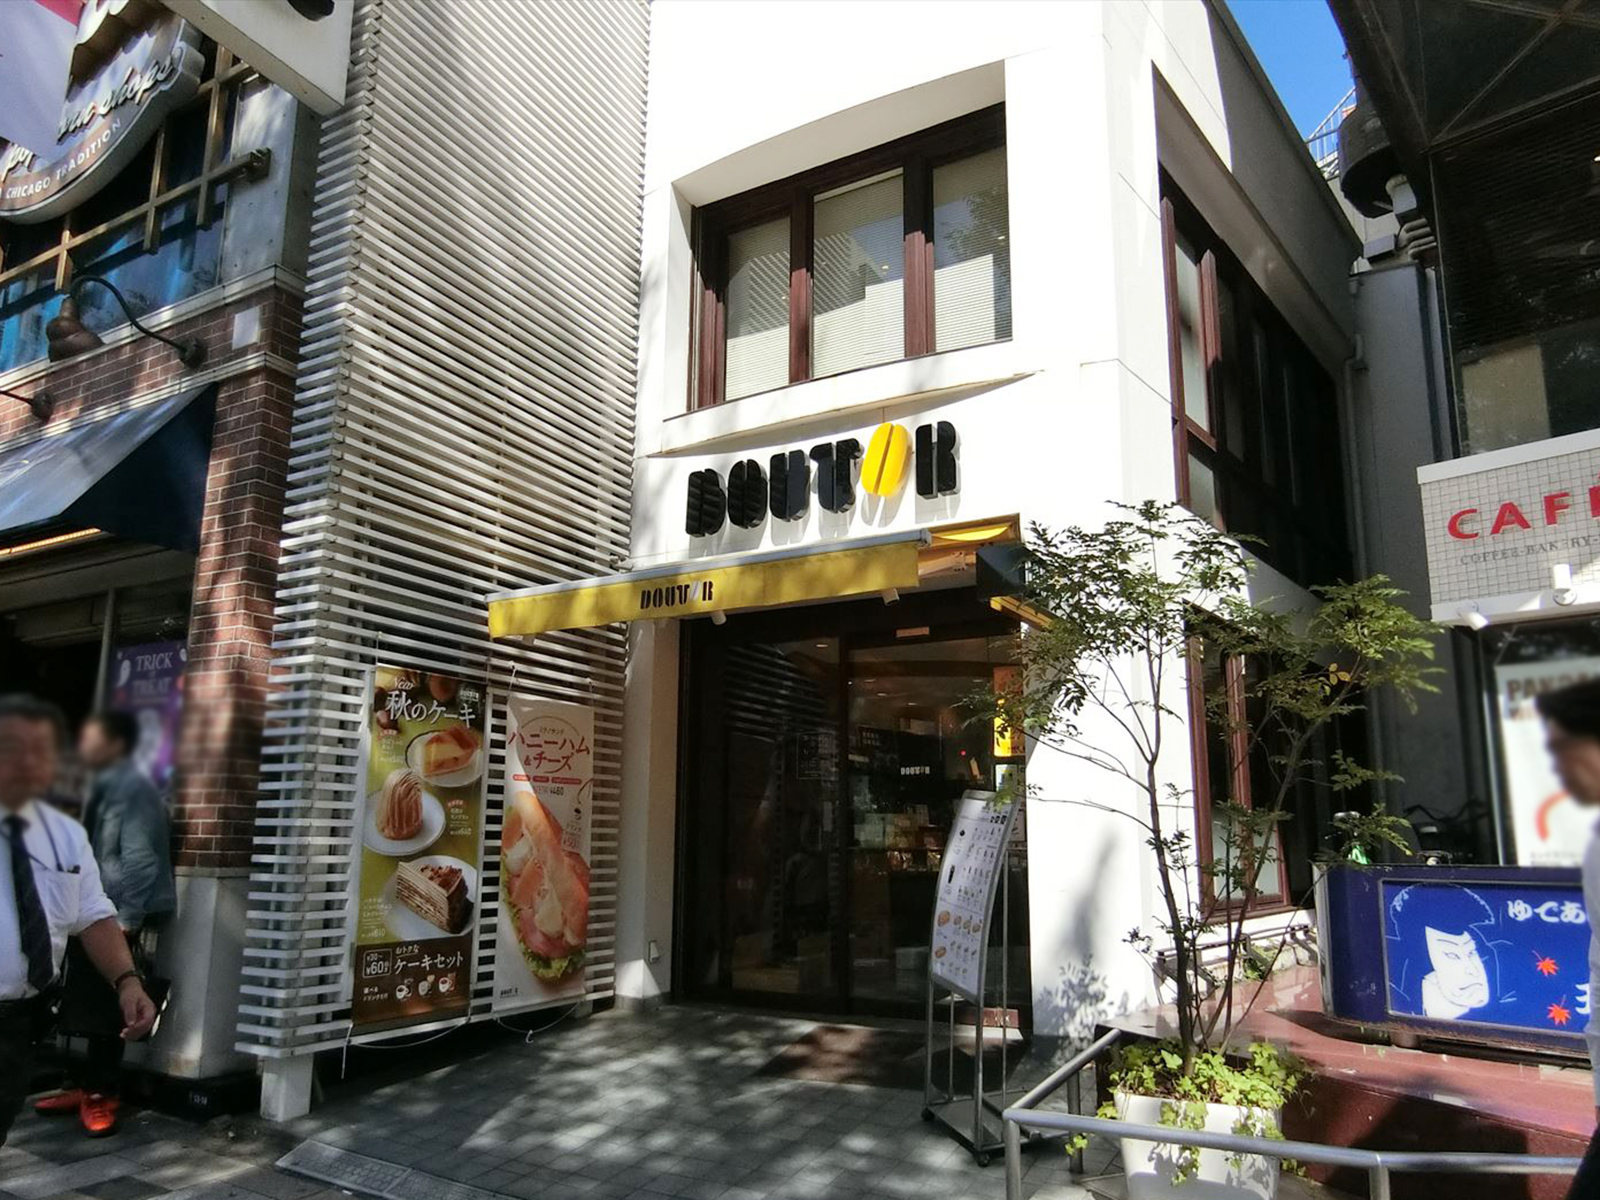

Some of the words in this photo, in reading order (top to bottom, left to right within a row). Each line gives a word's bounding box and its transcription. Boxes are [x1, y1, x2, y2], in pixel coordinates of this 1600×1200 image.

[6, 177, 51, 199] CHICAGO
[56, 118, 121, 180] TRADITION
[684, 420, 960, 538] DOUTOR
[136, 652, 174, 671] TRICK
[385, 689, 477, 729] 秋のケーキ
[507, 731, 591, 756] ハニーハム
[394, 950, 464, 975] ケーキセット
